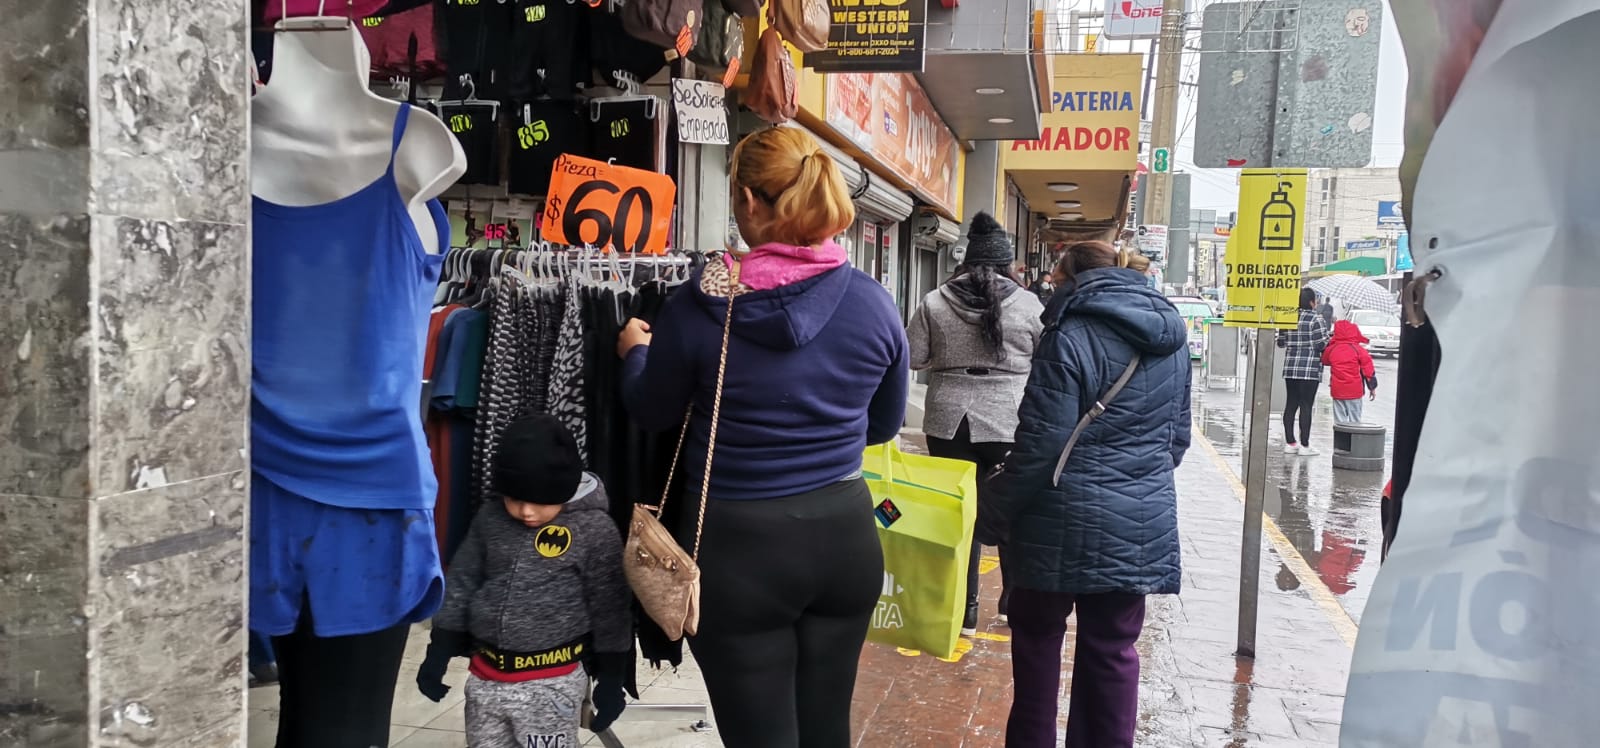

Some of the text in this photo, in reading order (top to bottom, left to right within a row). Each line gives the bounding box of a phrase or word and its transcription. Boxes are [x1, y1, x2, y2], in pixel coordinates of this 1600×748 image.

[833, 10, 909, 23] WESTERN
[856, 22, 909, 34] UNION
[1237, 263, 1301, 275] OBLIGATO
[1237, 277, 1300, 289] ANTIBACT
[514, 647, 571, 669] BATMAN
[527, 733, 566, 748] NYC
